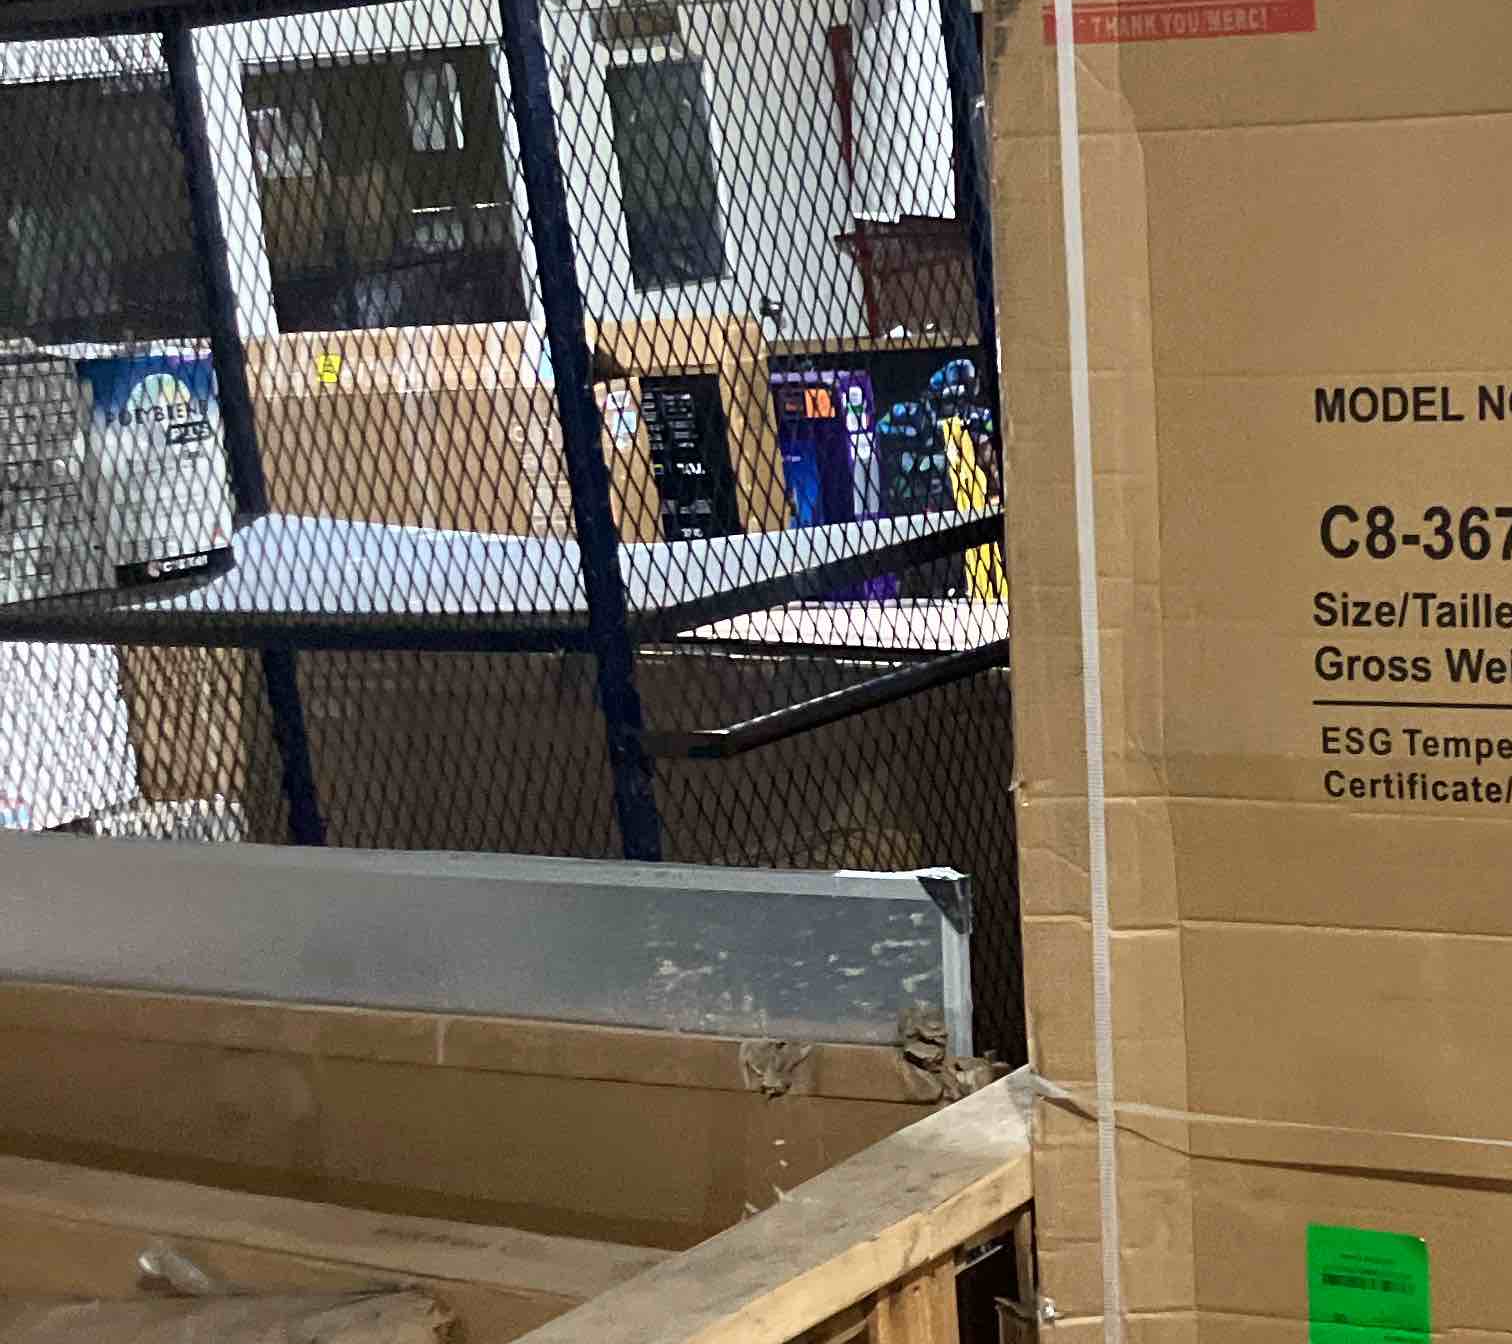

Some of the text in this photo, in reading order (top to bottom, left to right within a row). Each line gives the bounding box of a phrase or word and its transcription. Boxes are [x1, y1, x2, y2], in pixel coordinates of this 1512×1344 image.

[1314, 385, 1465, 423] MODEL
[1314, 646, 1432, 683] Gross
[1321, 726, 1392, 756] ESG
